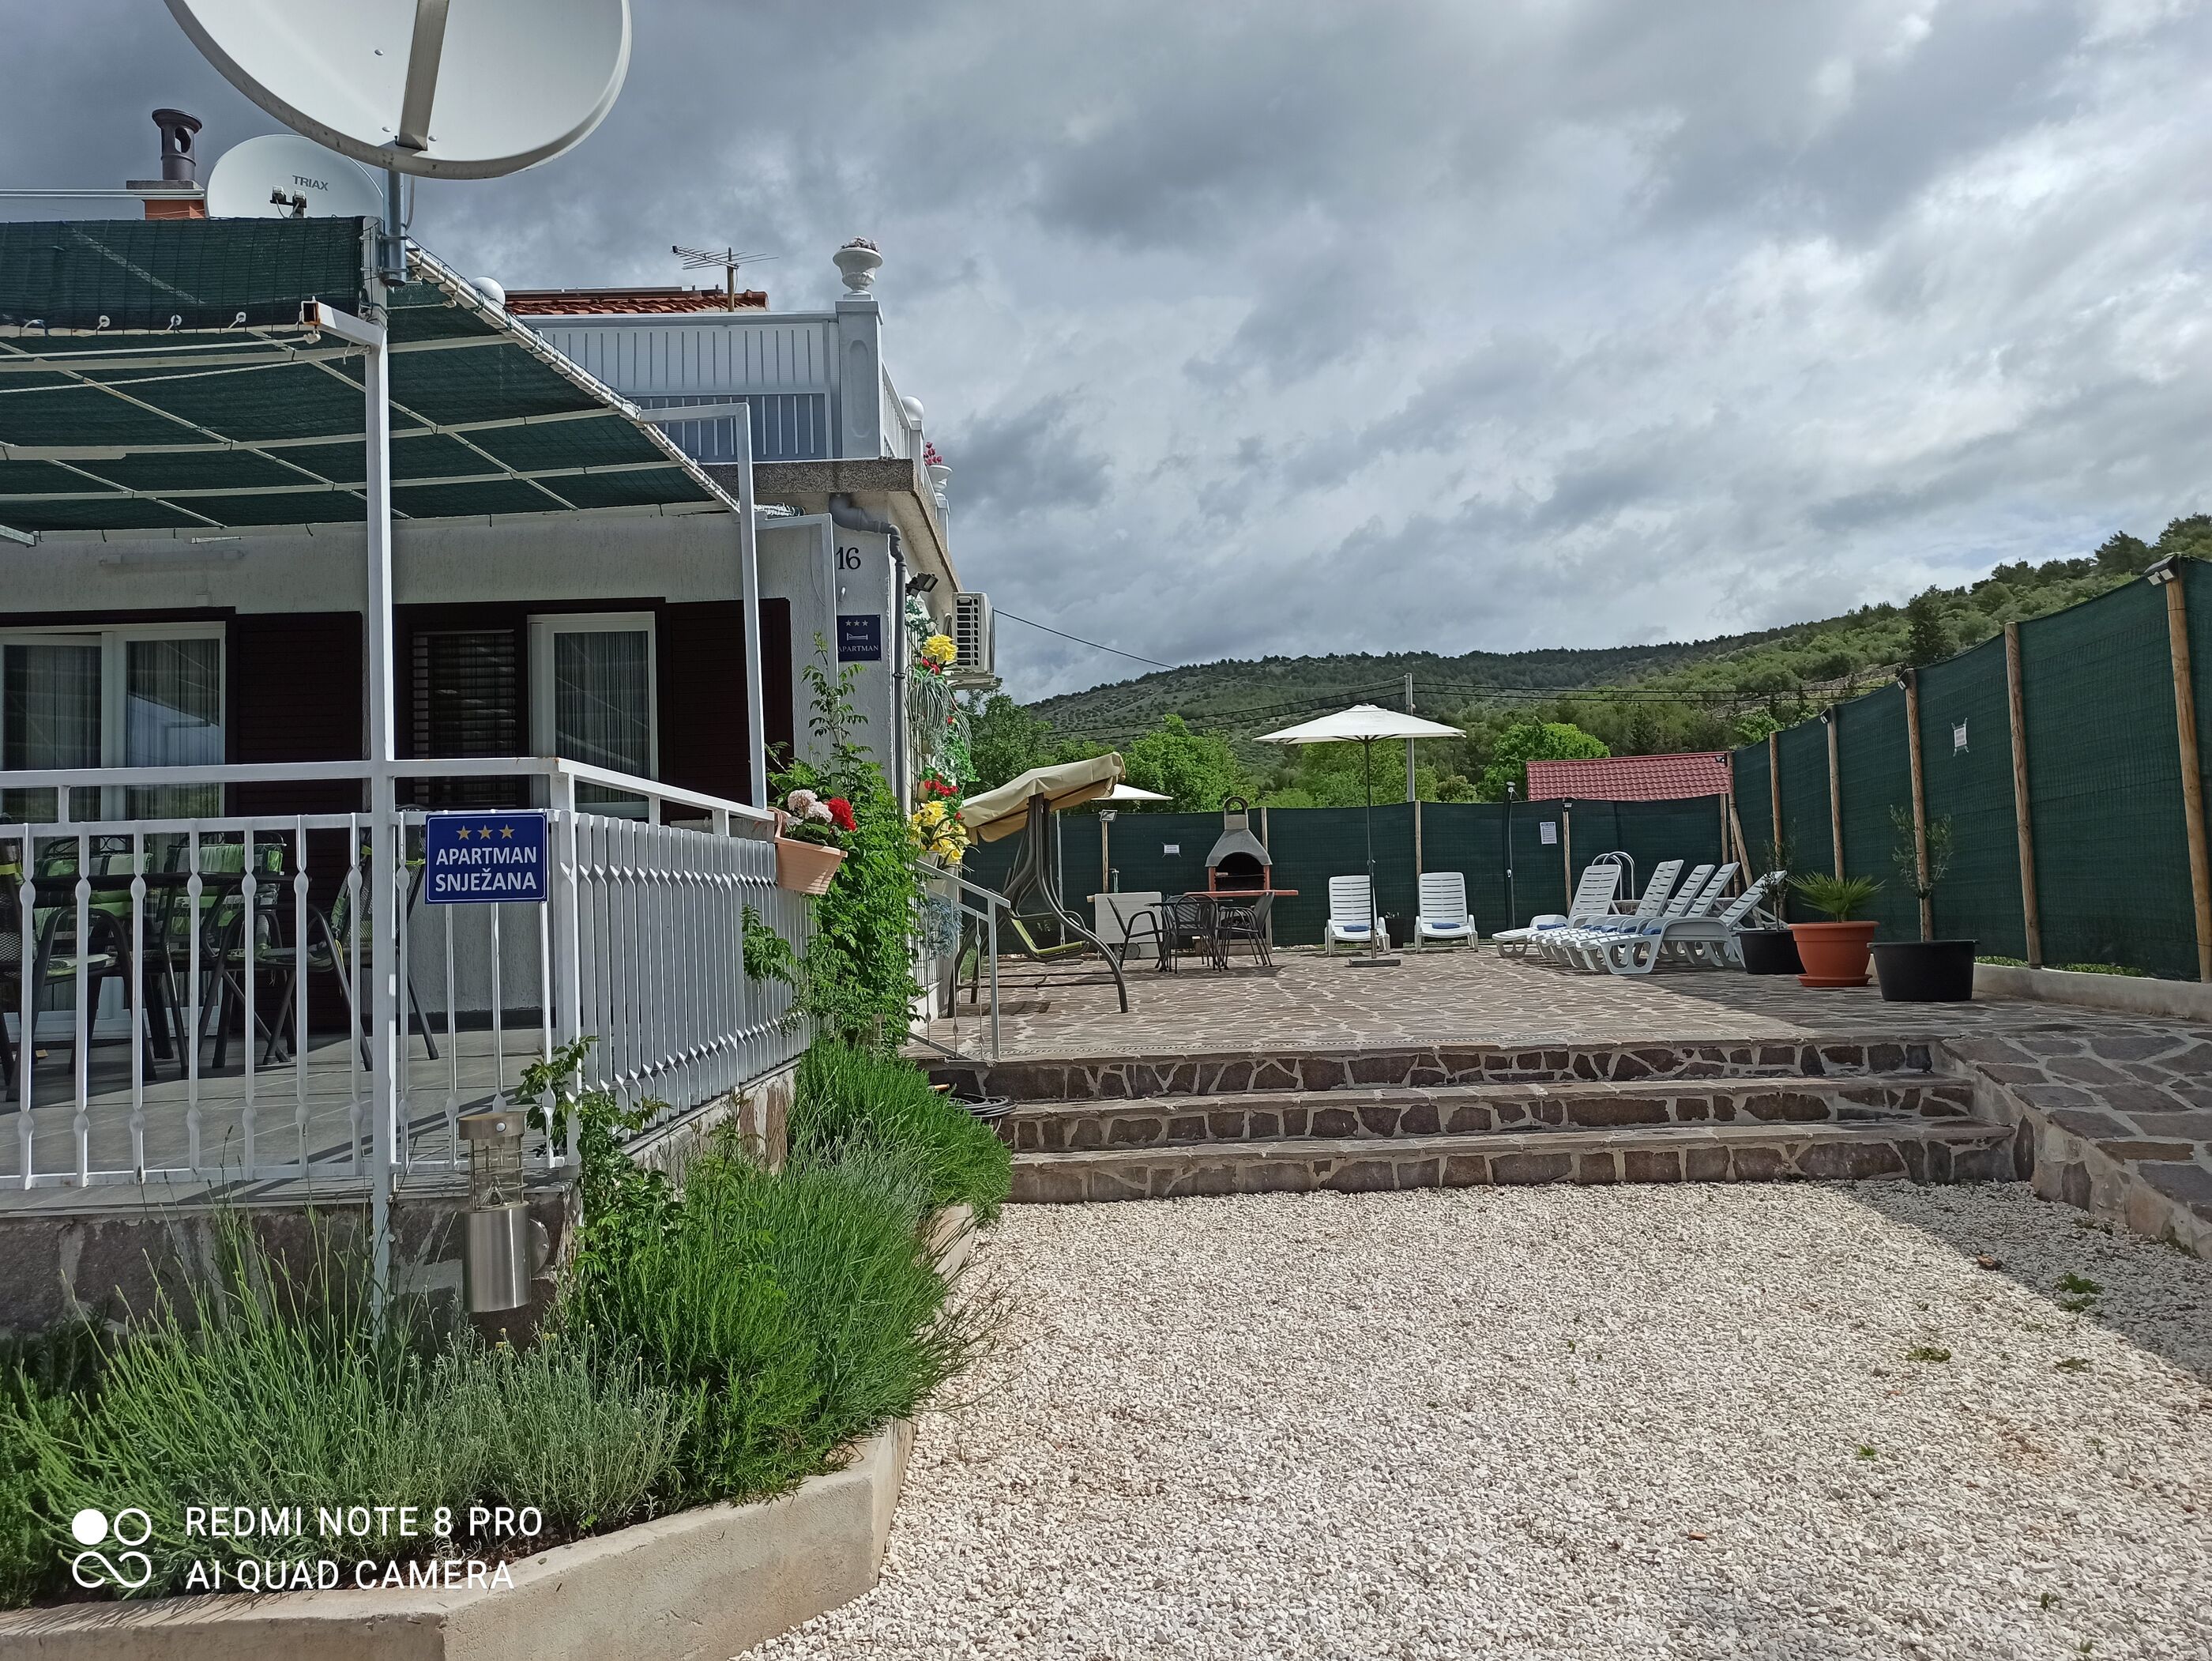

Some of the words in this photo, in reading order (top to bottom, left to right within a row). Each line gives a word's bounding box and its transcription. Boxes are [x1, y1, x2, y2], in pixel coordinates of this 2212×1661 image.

[292, 175, 329, 191] TRIAX
[836, 546, 861, 570] 16
[435, 846, 536, 865] APARTMAN
[435, 868, 536, 892] SNJEŽANA
